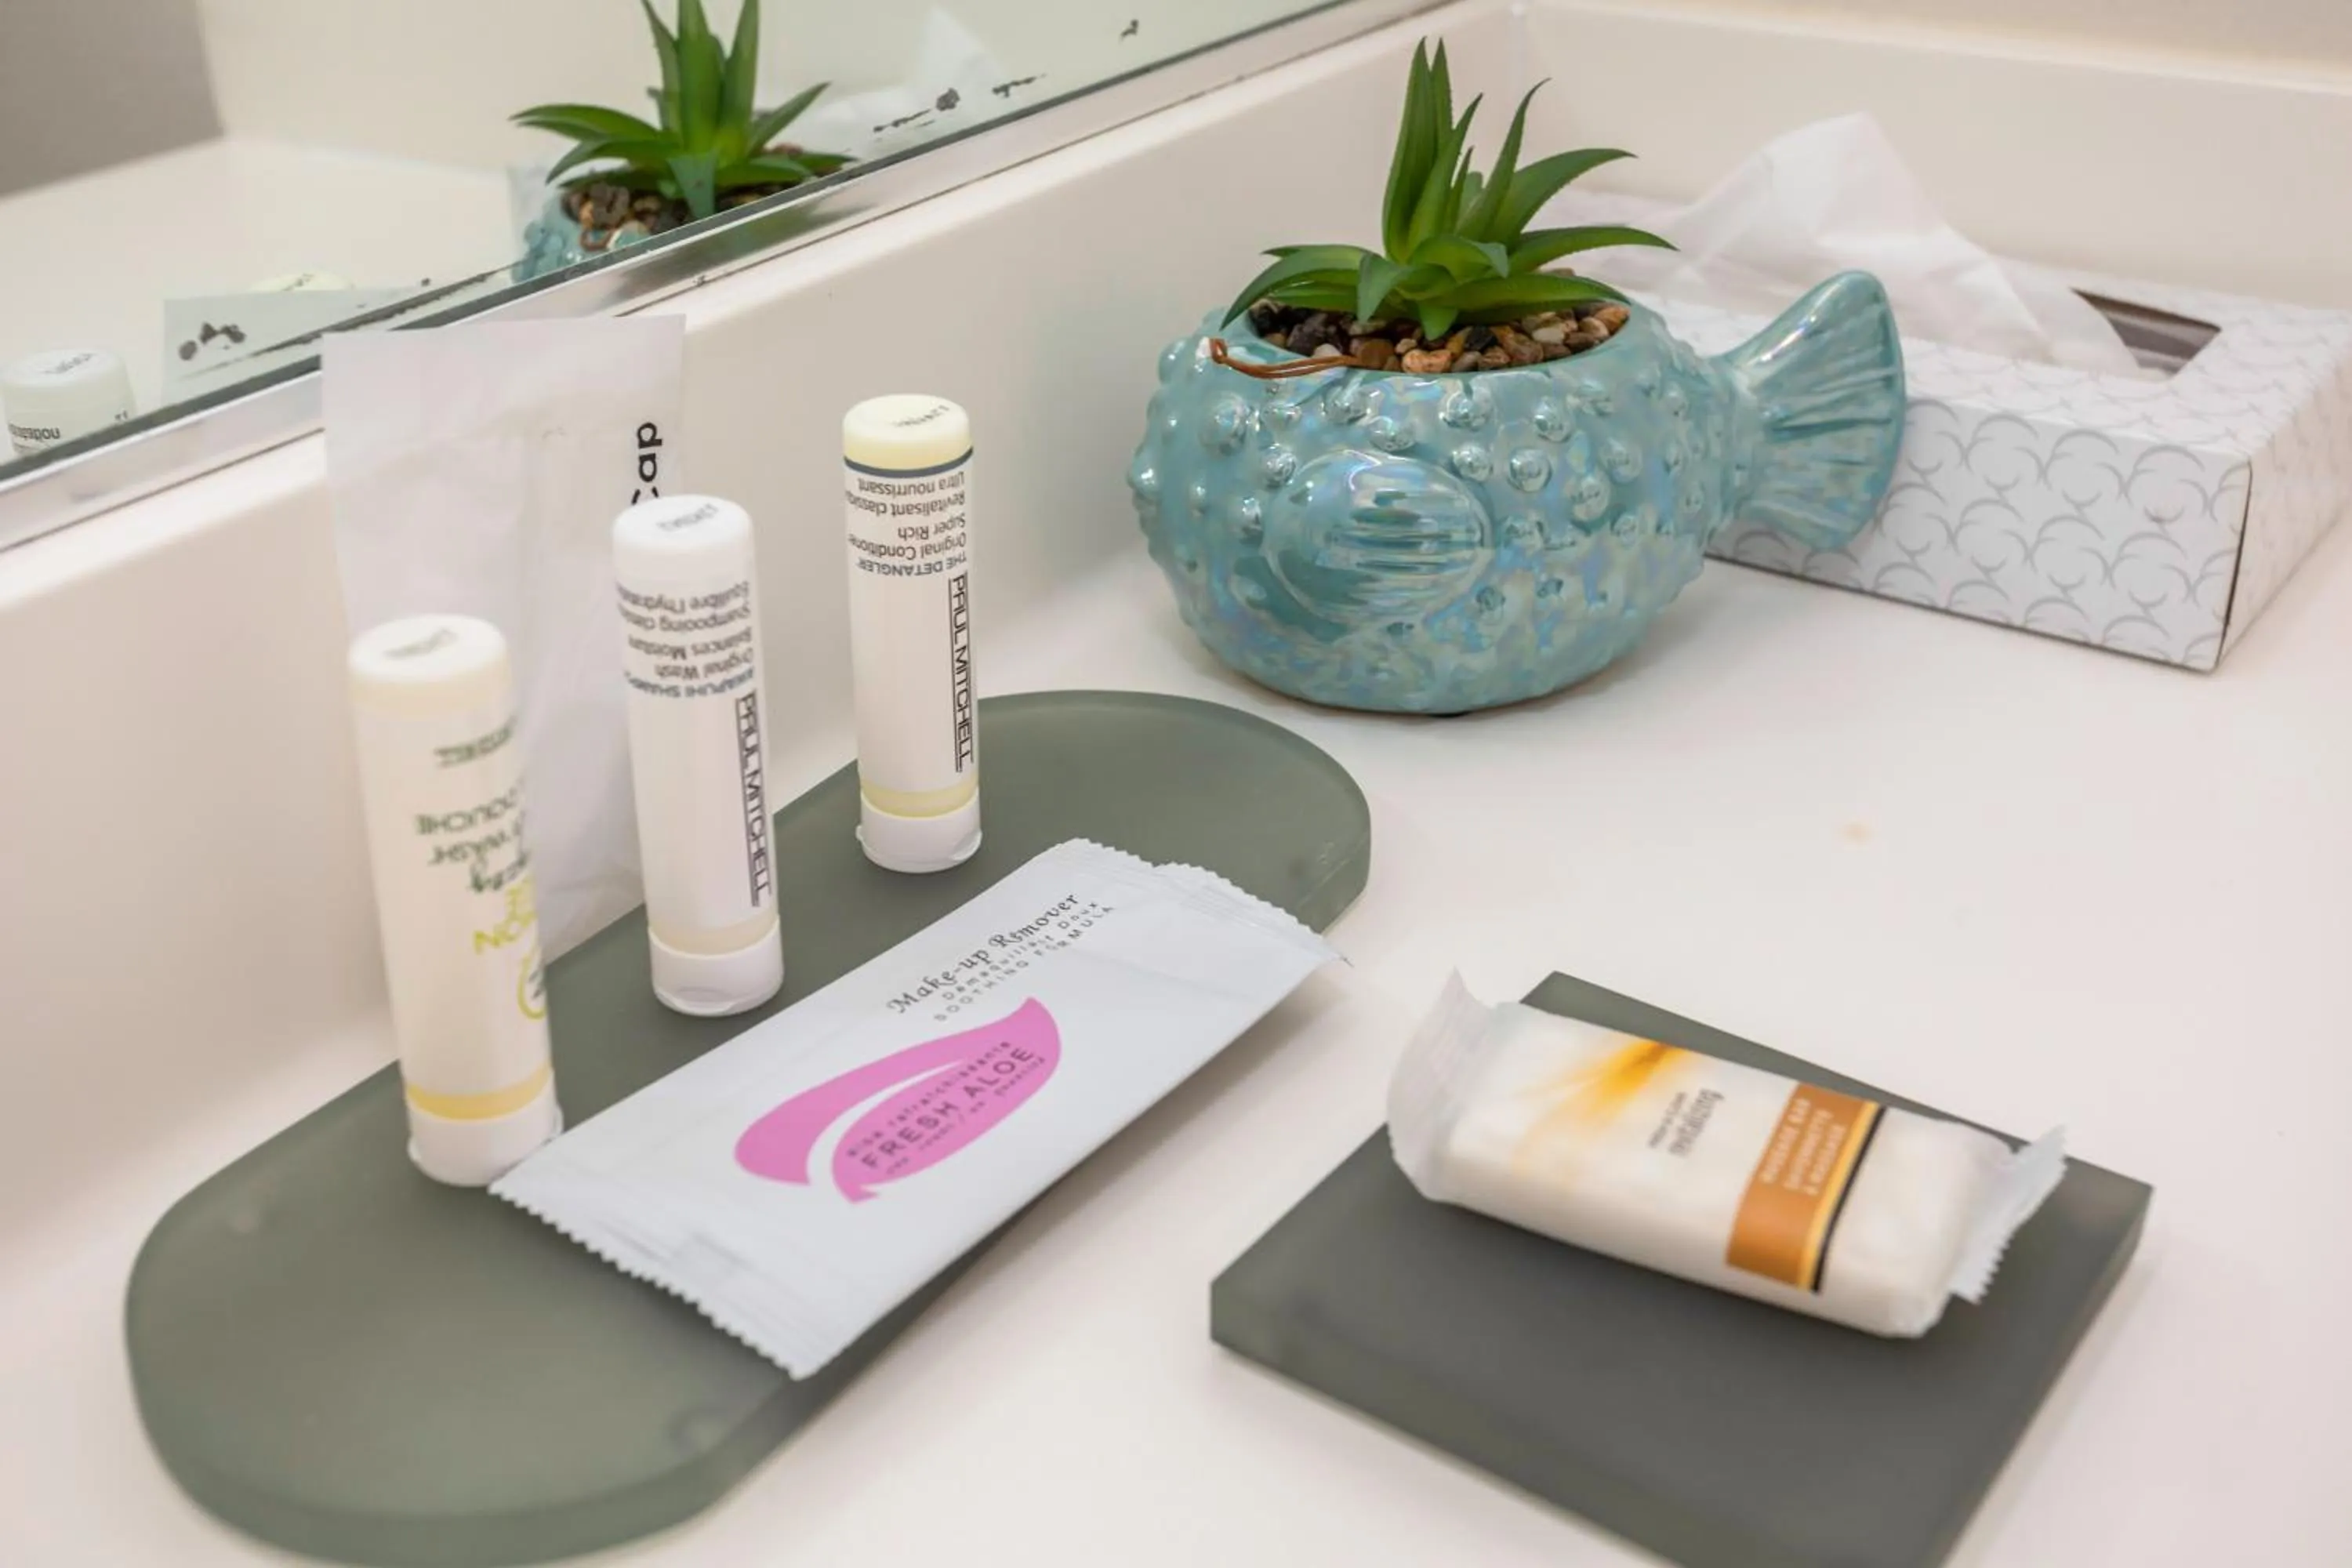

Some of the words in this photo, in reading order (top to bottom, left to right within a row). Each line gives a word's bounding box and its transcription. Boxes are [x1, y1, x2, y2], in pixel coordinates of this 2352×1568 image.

[857, 478, 935, 498] nourrissant
[938, 471, 966, 490] Ultra
[891, 490, 966, 517] Revitalisant
[898, 526, 929, 541] Rich
[934, 513, 966, 535] Super
[920, 532, 967, 558] Original
[946, 551, 967, 569] THE
[950, 575, 967, 644] PAUL
[953, 645, 972, 772] MITCHELL
[887, 948, 993, 1014] Make-up
[987, 894, 1080, 949] Remover
[860, 1100, 960, 1168] FRESH
[963, 1047, 1035, 1099] ALOE
